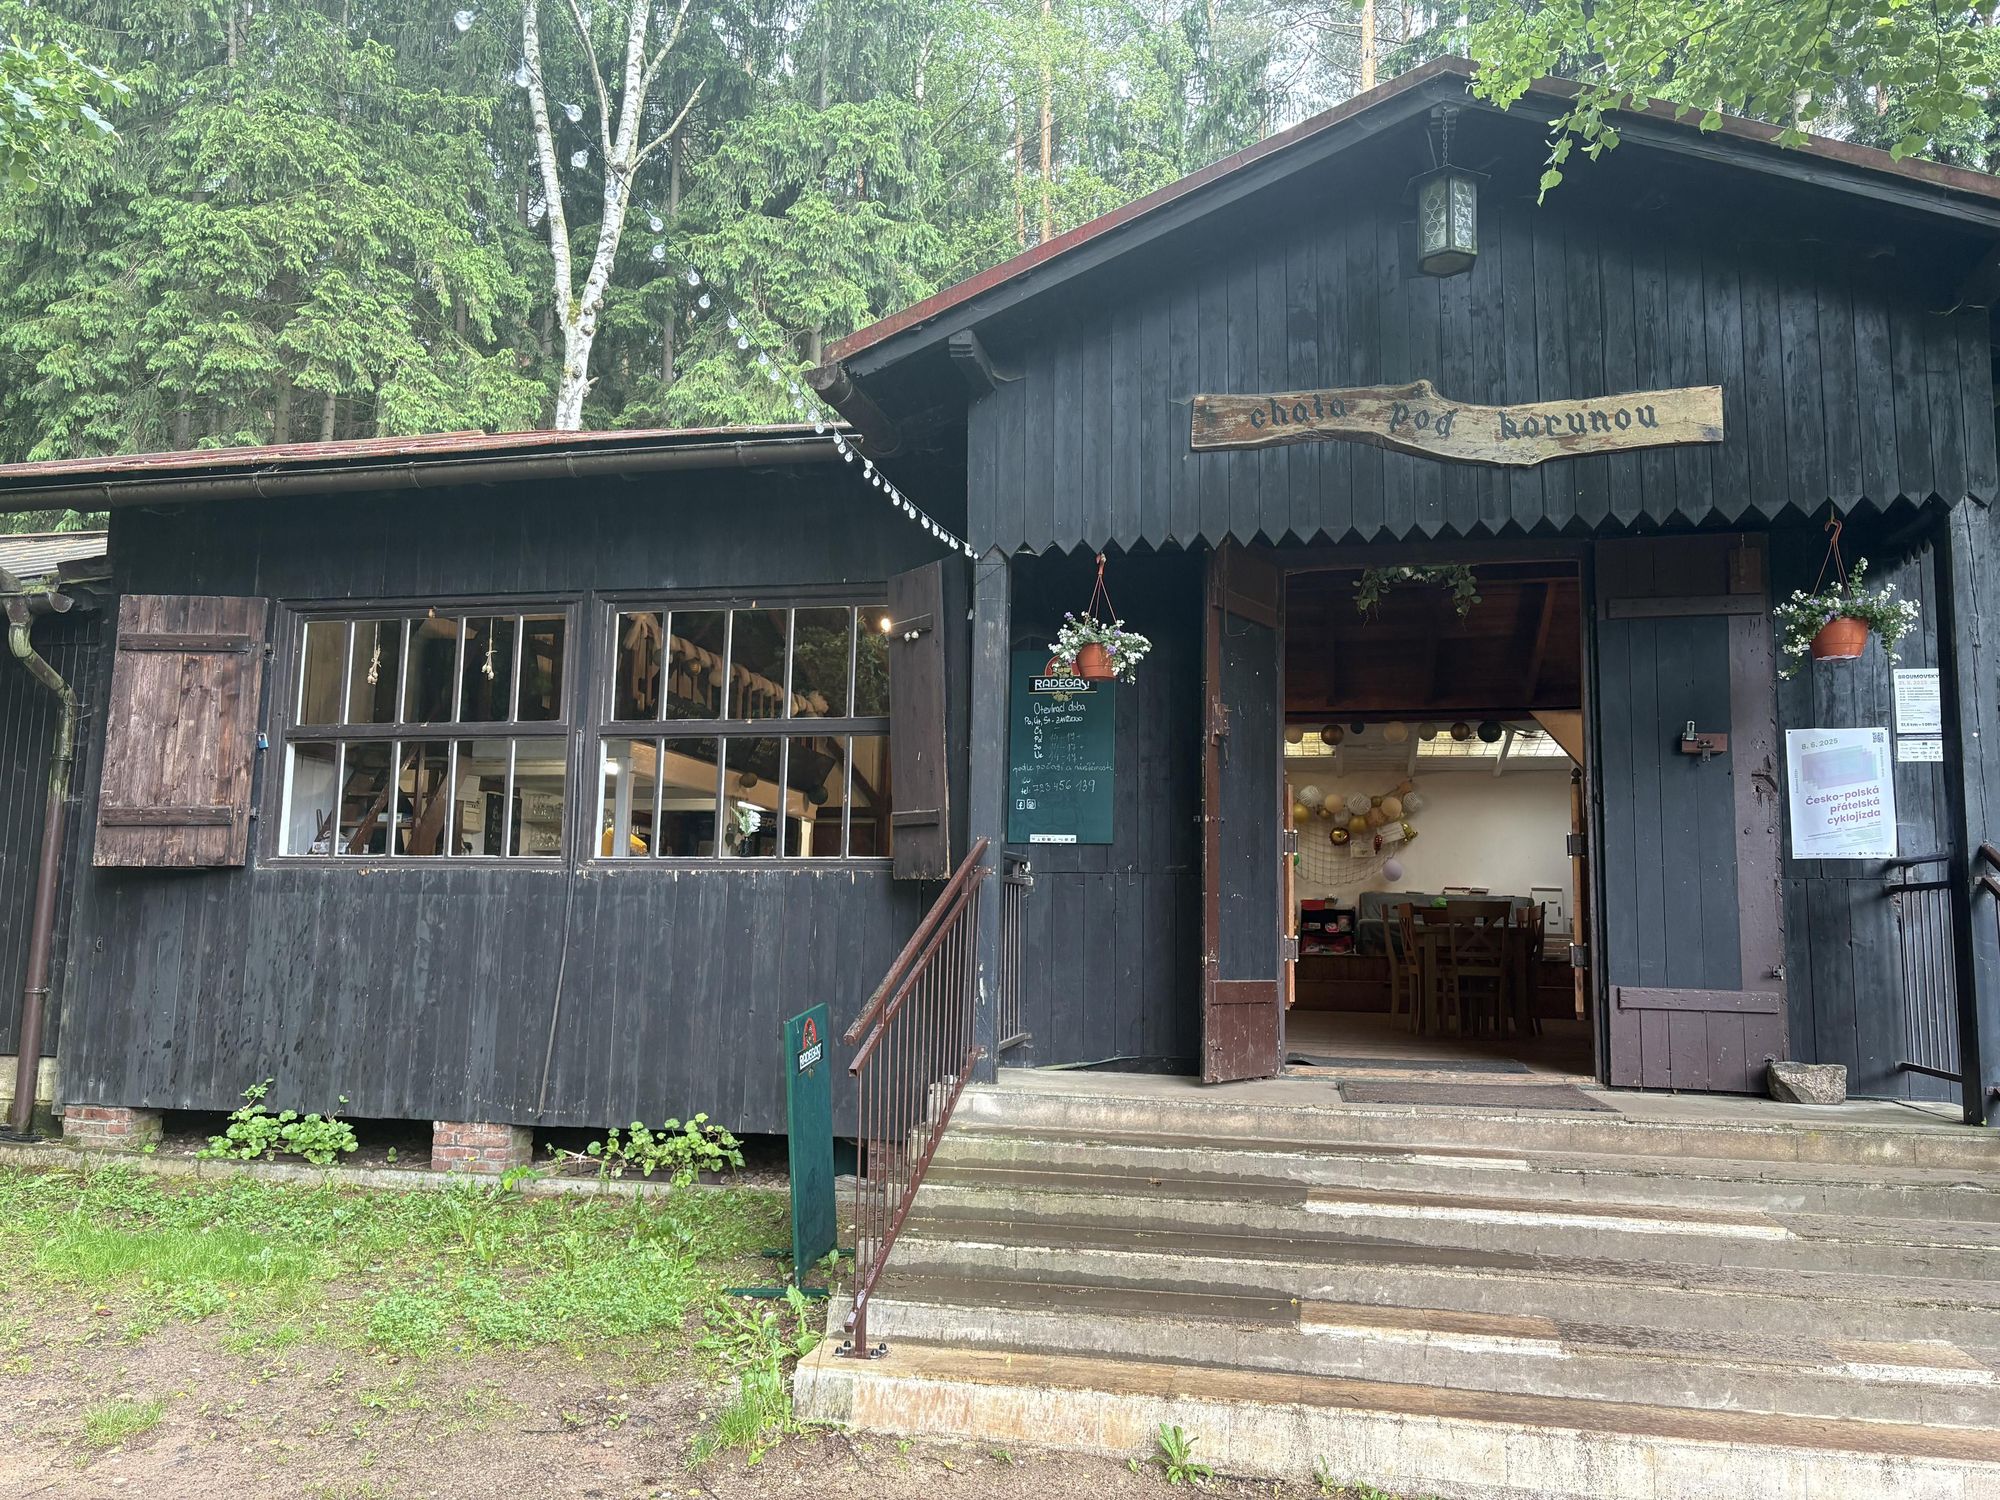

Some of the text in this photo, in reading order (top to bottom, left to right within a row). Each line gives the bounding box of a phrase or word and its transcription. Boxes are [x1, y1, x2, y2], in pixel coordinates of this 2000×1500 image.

[1251, 394, 1660, 440] chata pod korunou
[1068, 700, 1087, 712] doba
[1818, 738, 1839, 747] 2025
[1805, 785, 1880, 806] Česko-polská
[1830, 796, 1880, 815] přátelská
[1827, 809, 1881, 826] cyklojízda
